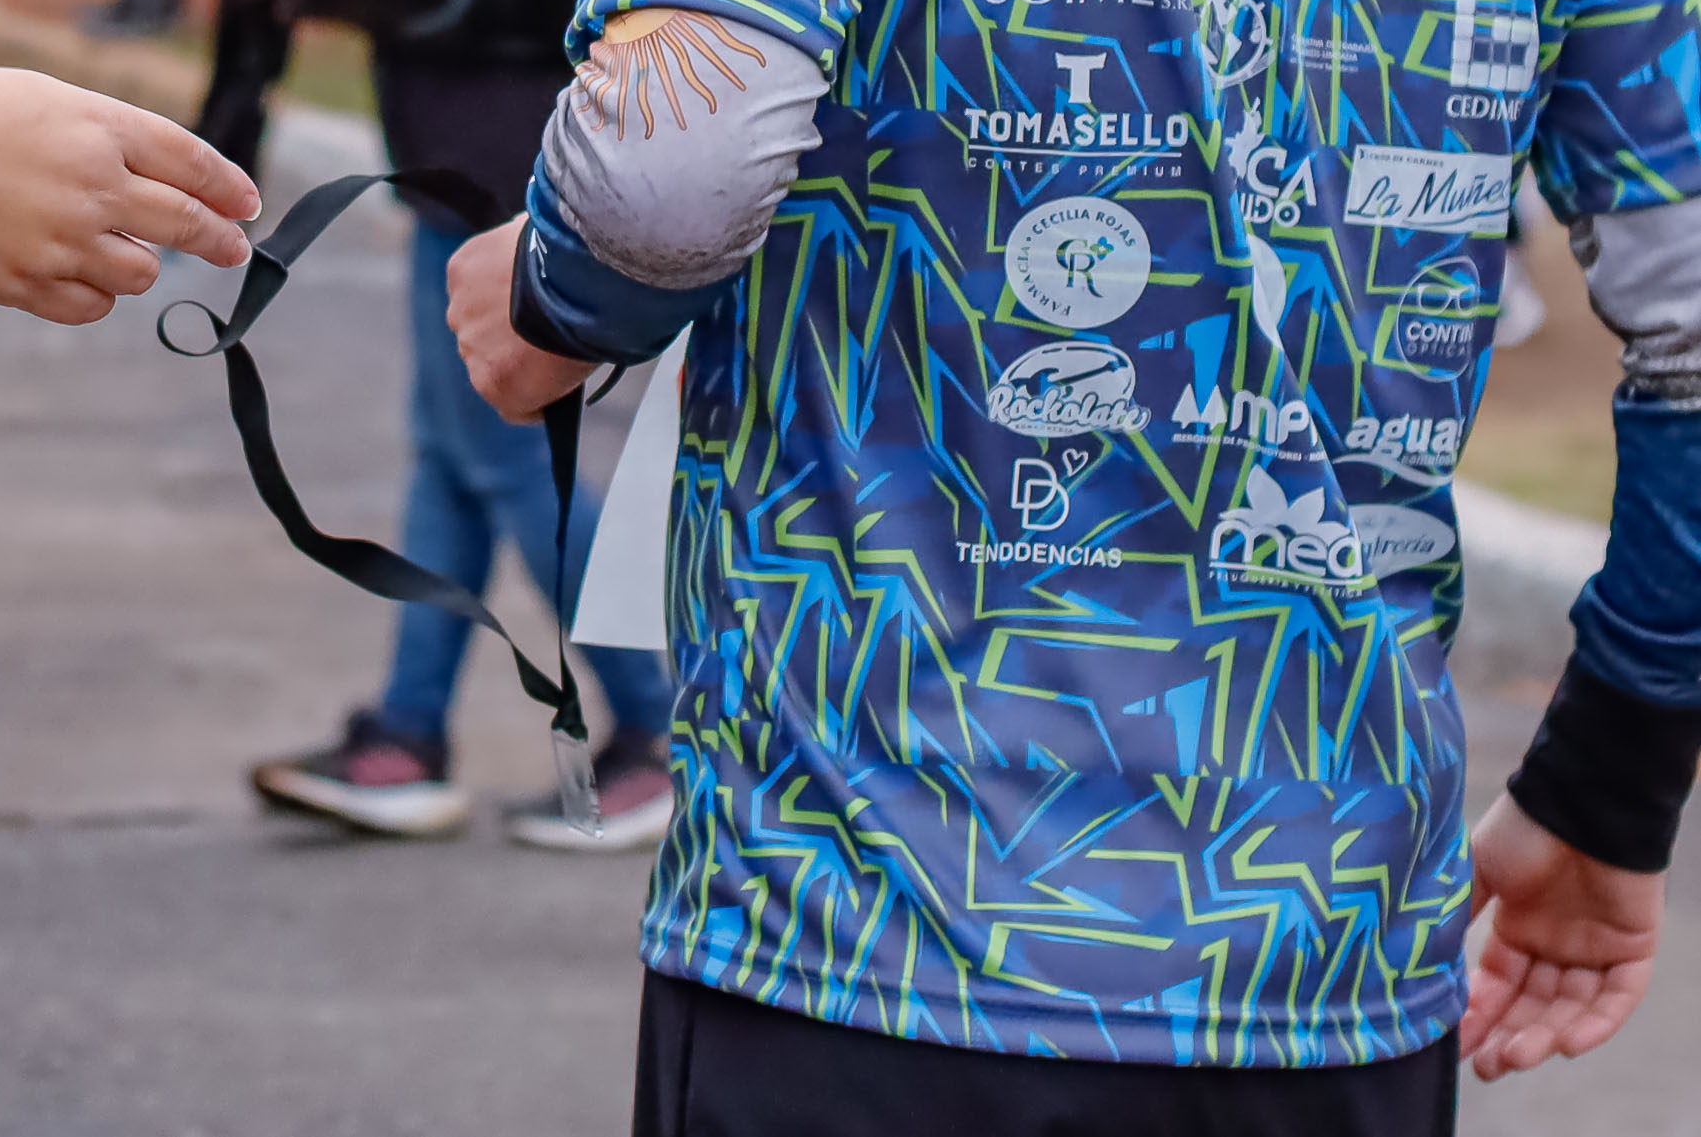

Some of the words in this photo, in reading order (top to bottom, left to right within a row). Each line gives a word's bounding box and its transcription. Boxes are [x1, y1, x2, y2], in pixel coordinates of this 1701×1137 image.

[964, 108, 1189, 148] TOMASELLO
[1032, 208, 1091, 235] CECILIA
[1095, 211, 1137, 248] ROJAS
[1017, 245, 1072, 317] FARMACIA
[988, 384, 1152, 432] Rockolate
[956, 541, 1123, 568] TENDDENCIAS
